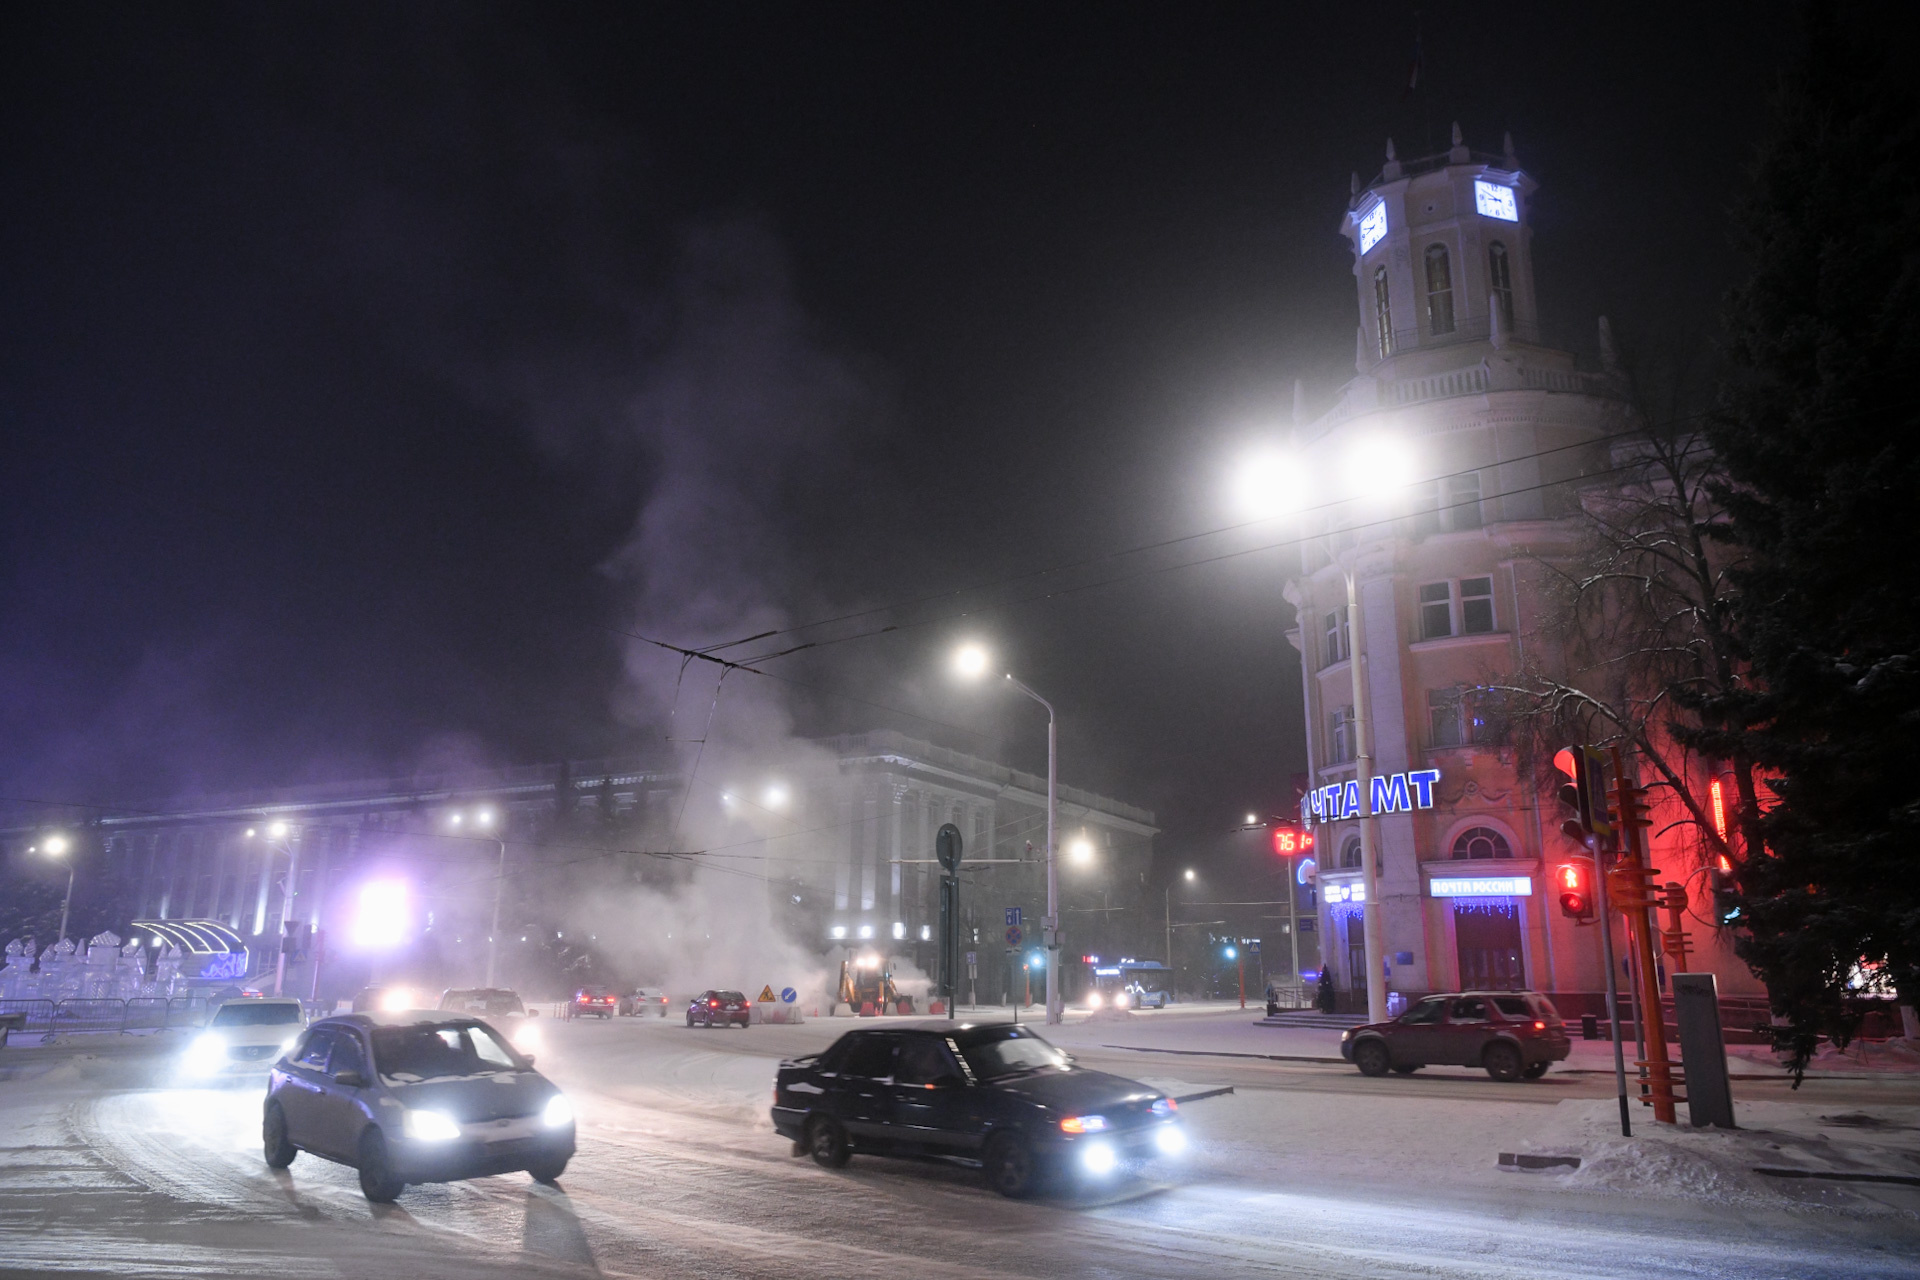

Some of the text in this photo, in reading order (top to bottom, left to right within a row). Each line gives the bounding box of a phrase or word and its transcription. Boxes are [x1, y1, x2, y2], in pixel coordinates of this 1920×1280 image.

[1300, 769, 1440, 831] ЧТАМТ
[1433, 881, 1514, 893] ПОЧТА РОССИИ
